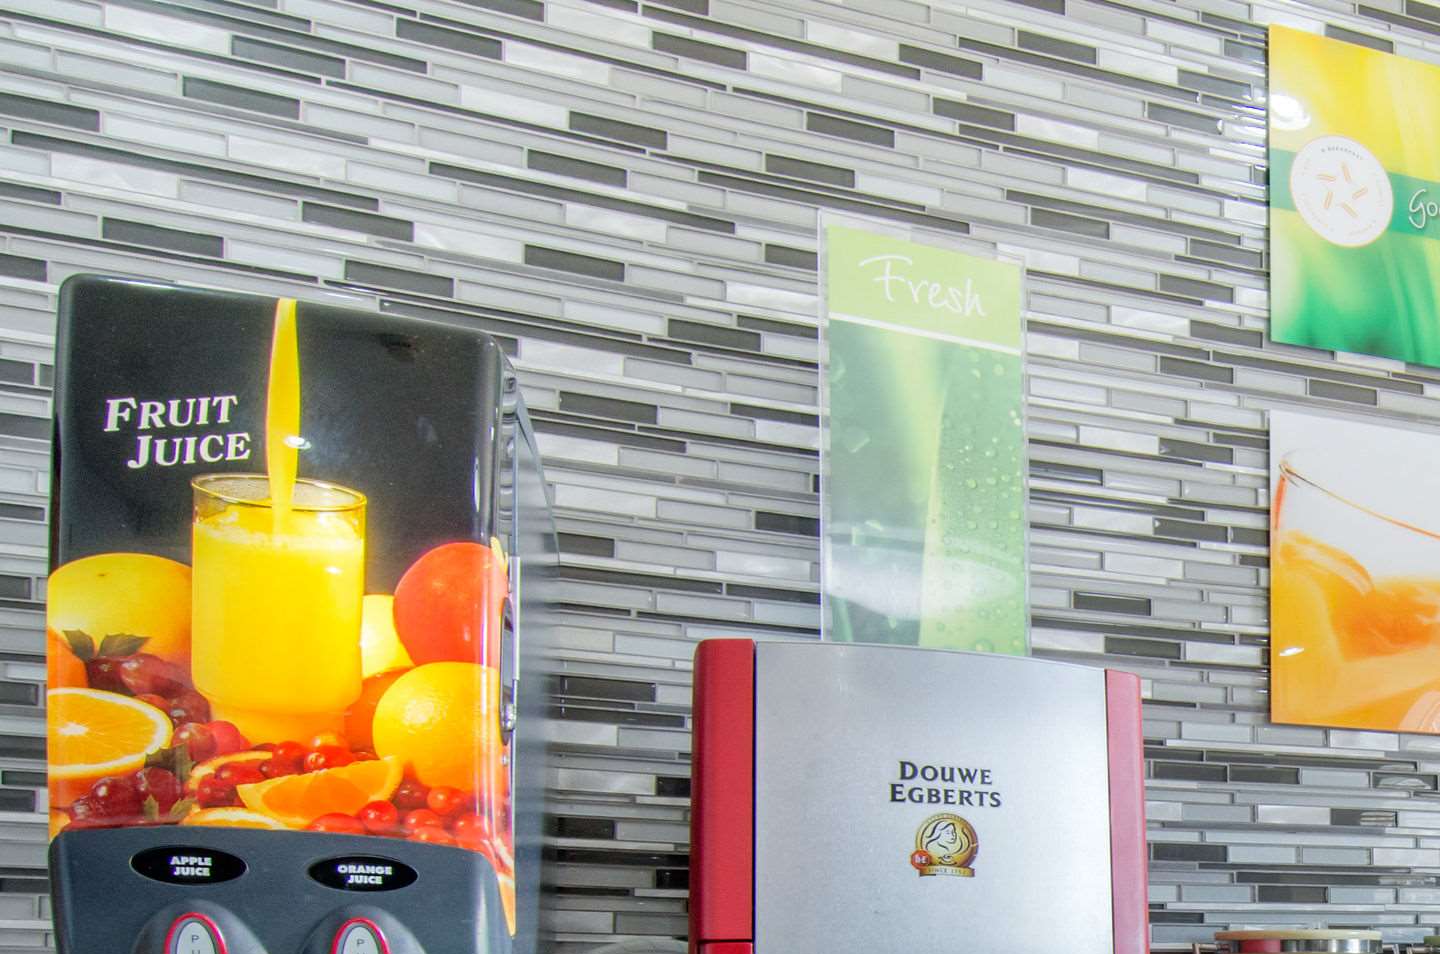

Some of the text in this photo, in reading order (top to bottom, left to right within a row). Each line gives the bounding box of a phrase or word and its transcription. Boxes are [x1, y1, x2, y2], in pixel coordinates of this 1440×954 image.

[858, 254, 988, 318] Fresh
[103, 394, 239, 432] FRUIT
[127, 432, 251, 469] JUICE
[899, 761, 993, 786] DOUWE
[889, 783, 1002, 808] EGBERTS
[170, 856, 213, 867] APPLE
[173, 867, 211, 877] JUICE
[337, 864, 393, 876] ORANGE
[346, 875, 383, 885] JUICE
